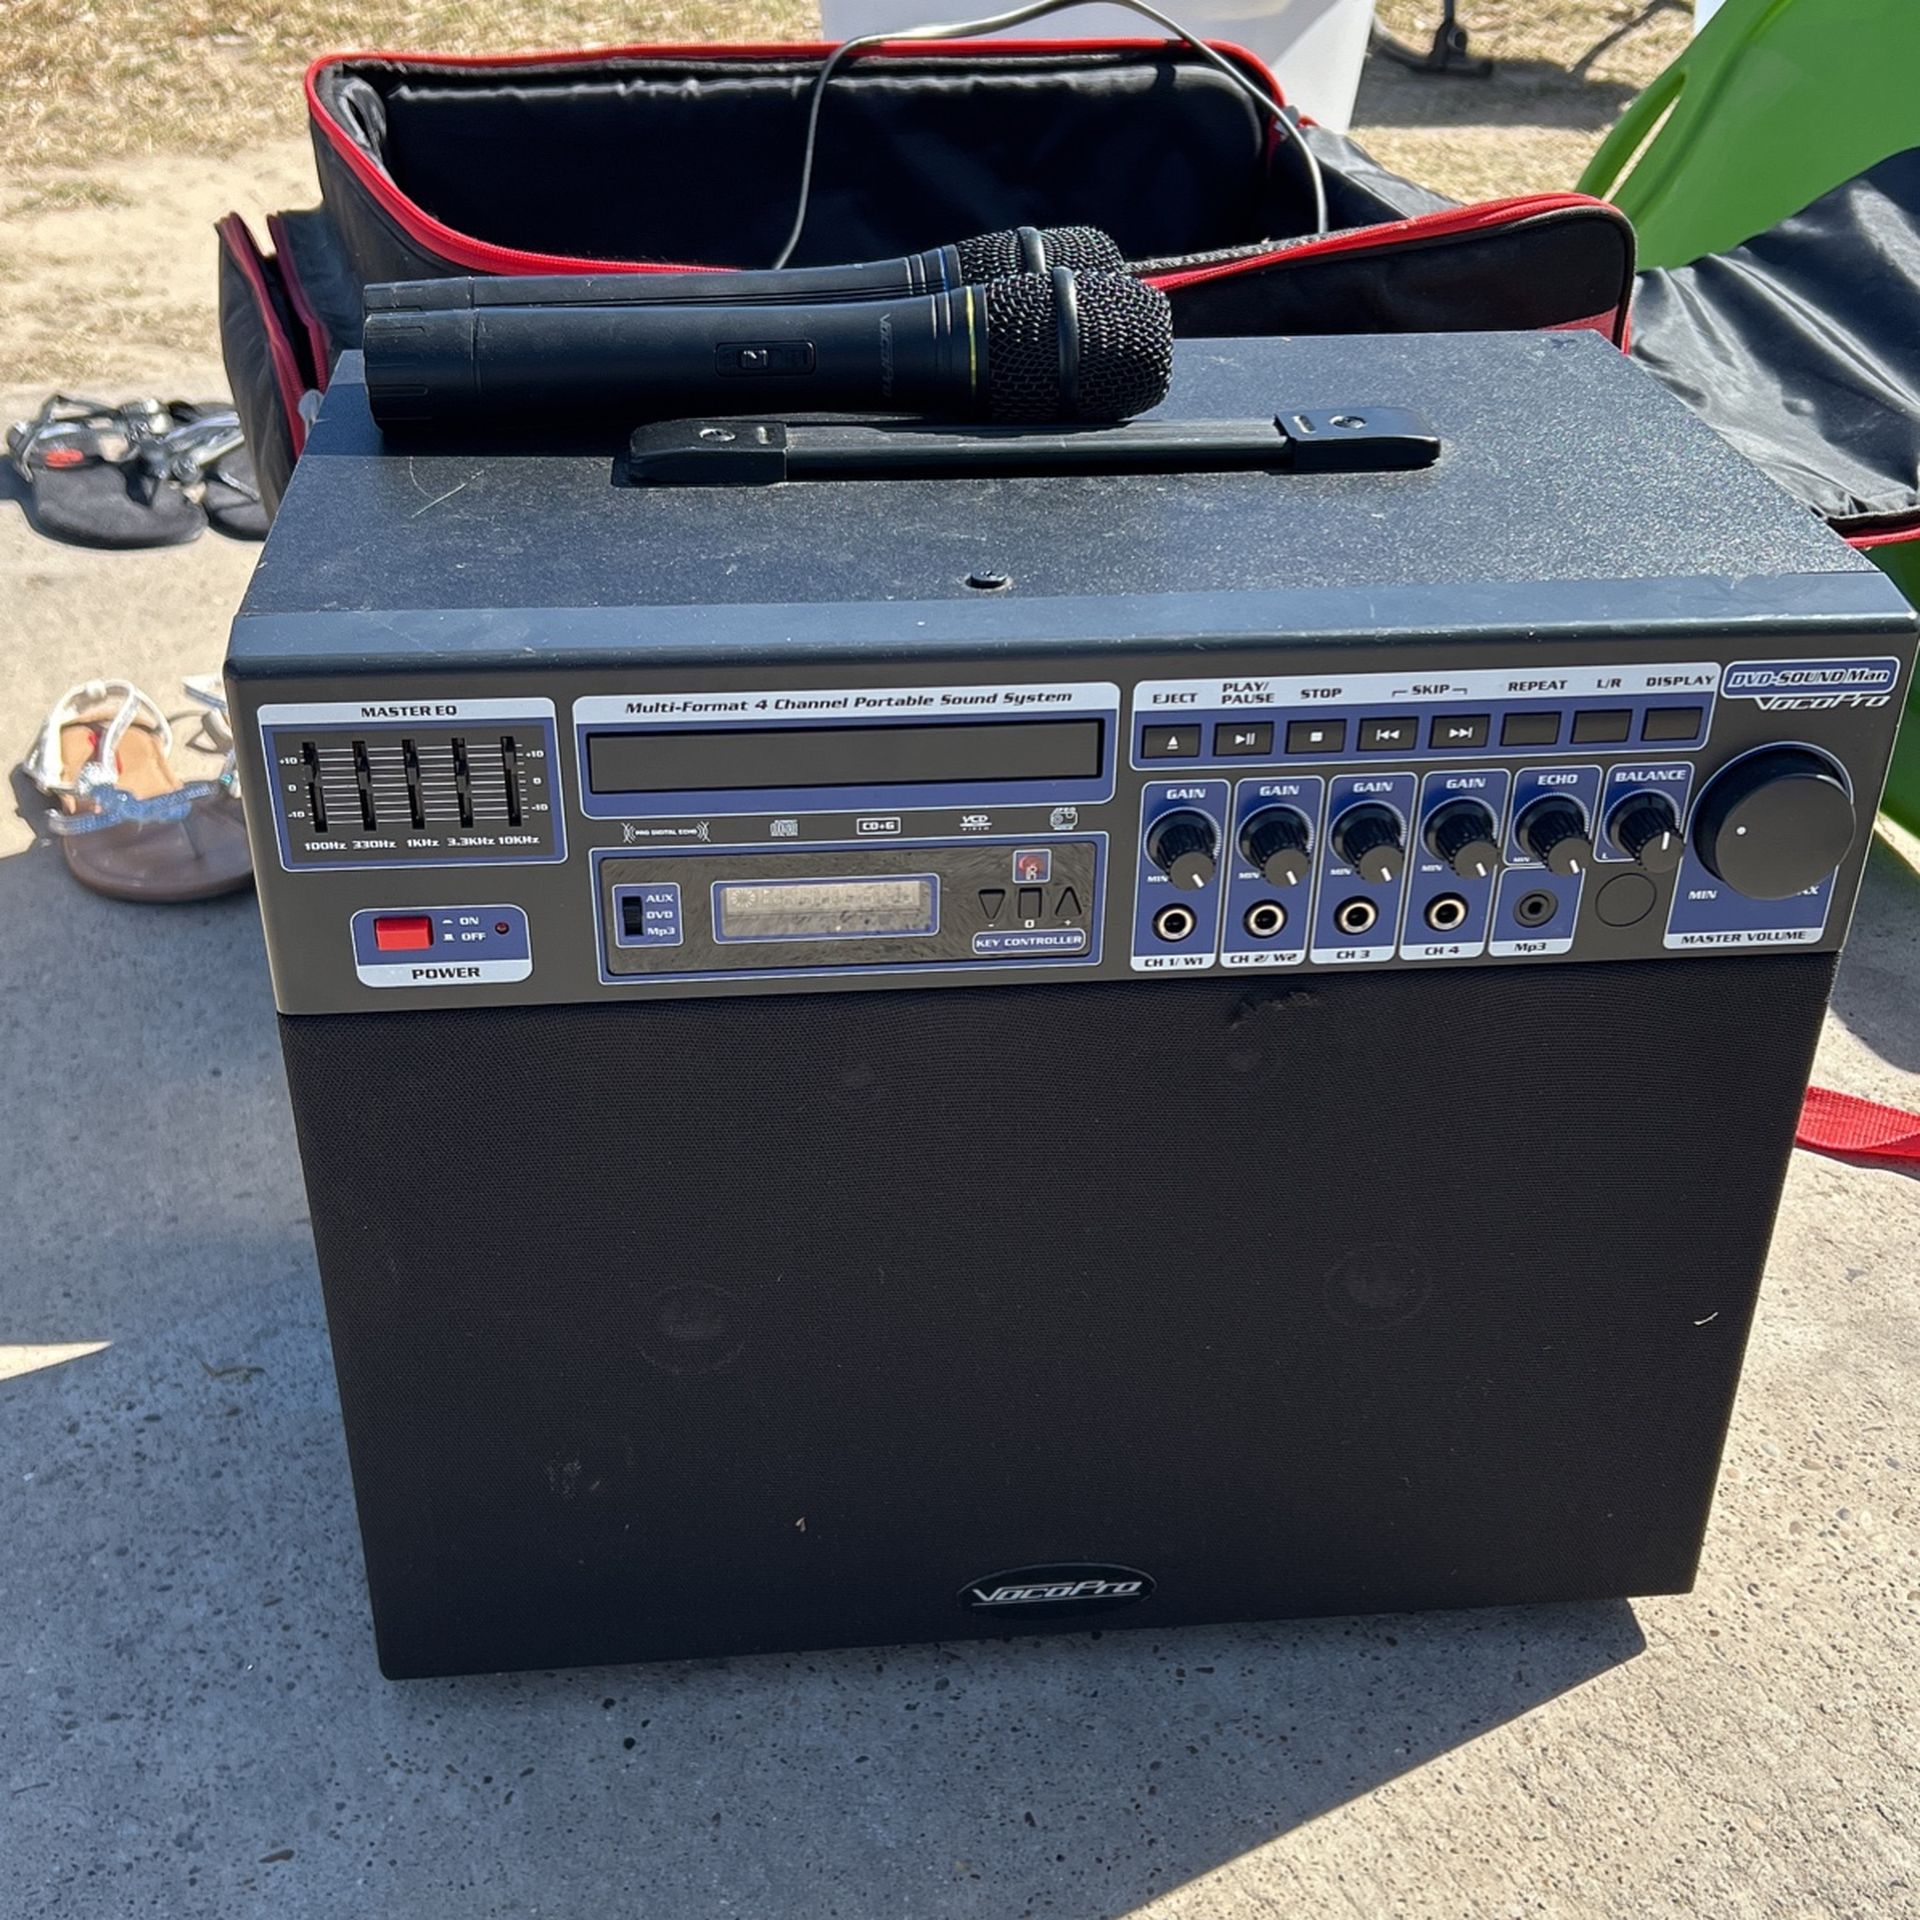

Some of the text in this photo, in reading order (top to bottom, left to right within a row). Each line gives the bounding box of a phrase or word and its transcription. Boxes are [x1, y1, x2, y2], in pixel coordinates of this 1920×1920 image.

[1508, 680, 1568, 692] REPEAT
[1597, 678, 1622, 688] L/R
[1646, 676, 1715, 687] DISPLAY
[1222, 682, 1270, 693] PLAY/
[1412, 684, 1450, 695] SKIP
[1153, 693, 1197, 704] EJECT
[1221, 693, 1275, 705] PAUSE
[1300, 688, 1342, 699] STOP
[625, 691, 1072, 714] Multi-Format 4 Channel Portable Sound System
[1753, 694, 1891, 710] VocoPro
[361, 705, 457, 717] MASTER EQ
[533, 777, 542, 785] 0
[1538, 774, 1578, 786] ECHO
[1615, 770, 1686, 782] BALANCE
[288, 784, 297, 792] 0
[1353, 781, 1394, 794] GAIN
[1446, 778, 1486, 790] GAIN
[1166, 788, 1206, 800] GAIN
[1259, 785, 1300, 797] GAIN
[305, 835, 540, 851] 100Hz 330Hz 1KHz 3.3KHz 10KHz
[646, 894, 674, 903] AUX
[1688, 890, 1717, 900] MIN
[459, 916, 479, 925] ON
[646, 911, 673, 919] DVD
[1025, 920, 1035, 928] 0
[461, 932, 486, 941] OFF
[647, 927, 675, 937] Mp3
[1681, 930, 1807, 944] MASTER VOLUME
[976, 935, 1083, 948] KEY CONTROLLER
[1425, 946, 1460, 955] CH 4
[1514, 942, 1547, 953] Mp3
[1230, 955, 1249, 964] CH
[1336, 950, 1370, 959] CH 3
[1145, 959, 1164, 968] CH
[412, 967, 481, 980] POWER
[972, 1580, 1143, 1602] VocoPro
